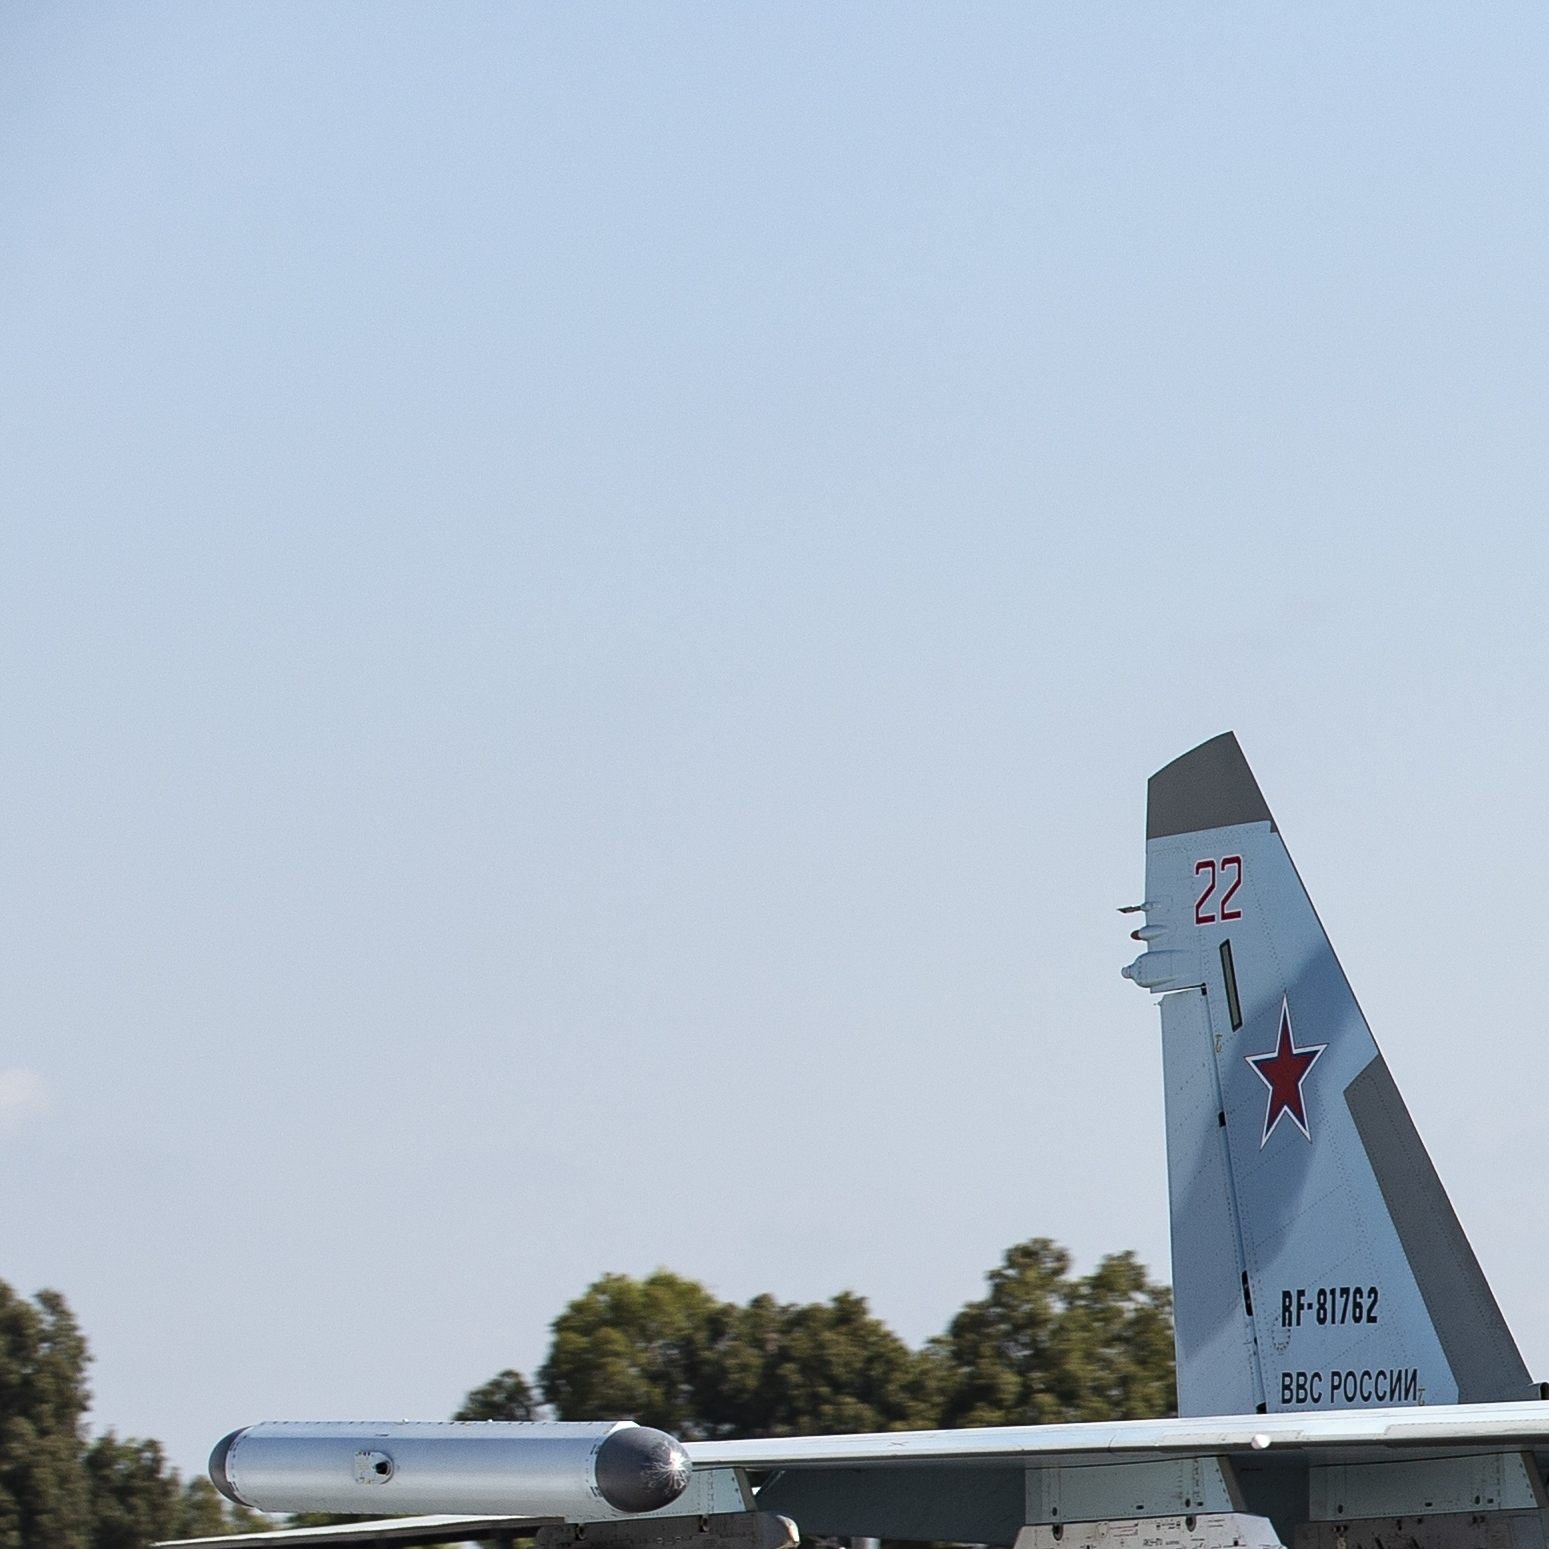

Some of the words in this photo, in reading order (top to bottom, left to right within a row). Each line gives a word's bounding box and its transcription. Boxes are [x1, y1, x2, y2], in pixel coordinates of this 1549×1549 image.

[1194, 854, 1243, 926] 22
[1281, 1286, 1379, 1328] RF-81762
[1281, 1371, 1323, 1405] ВВС
[1331, 1369, 1418, 1404] РОССИИ
